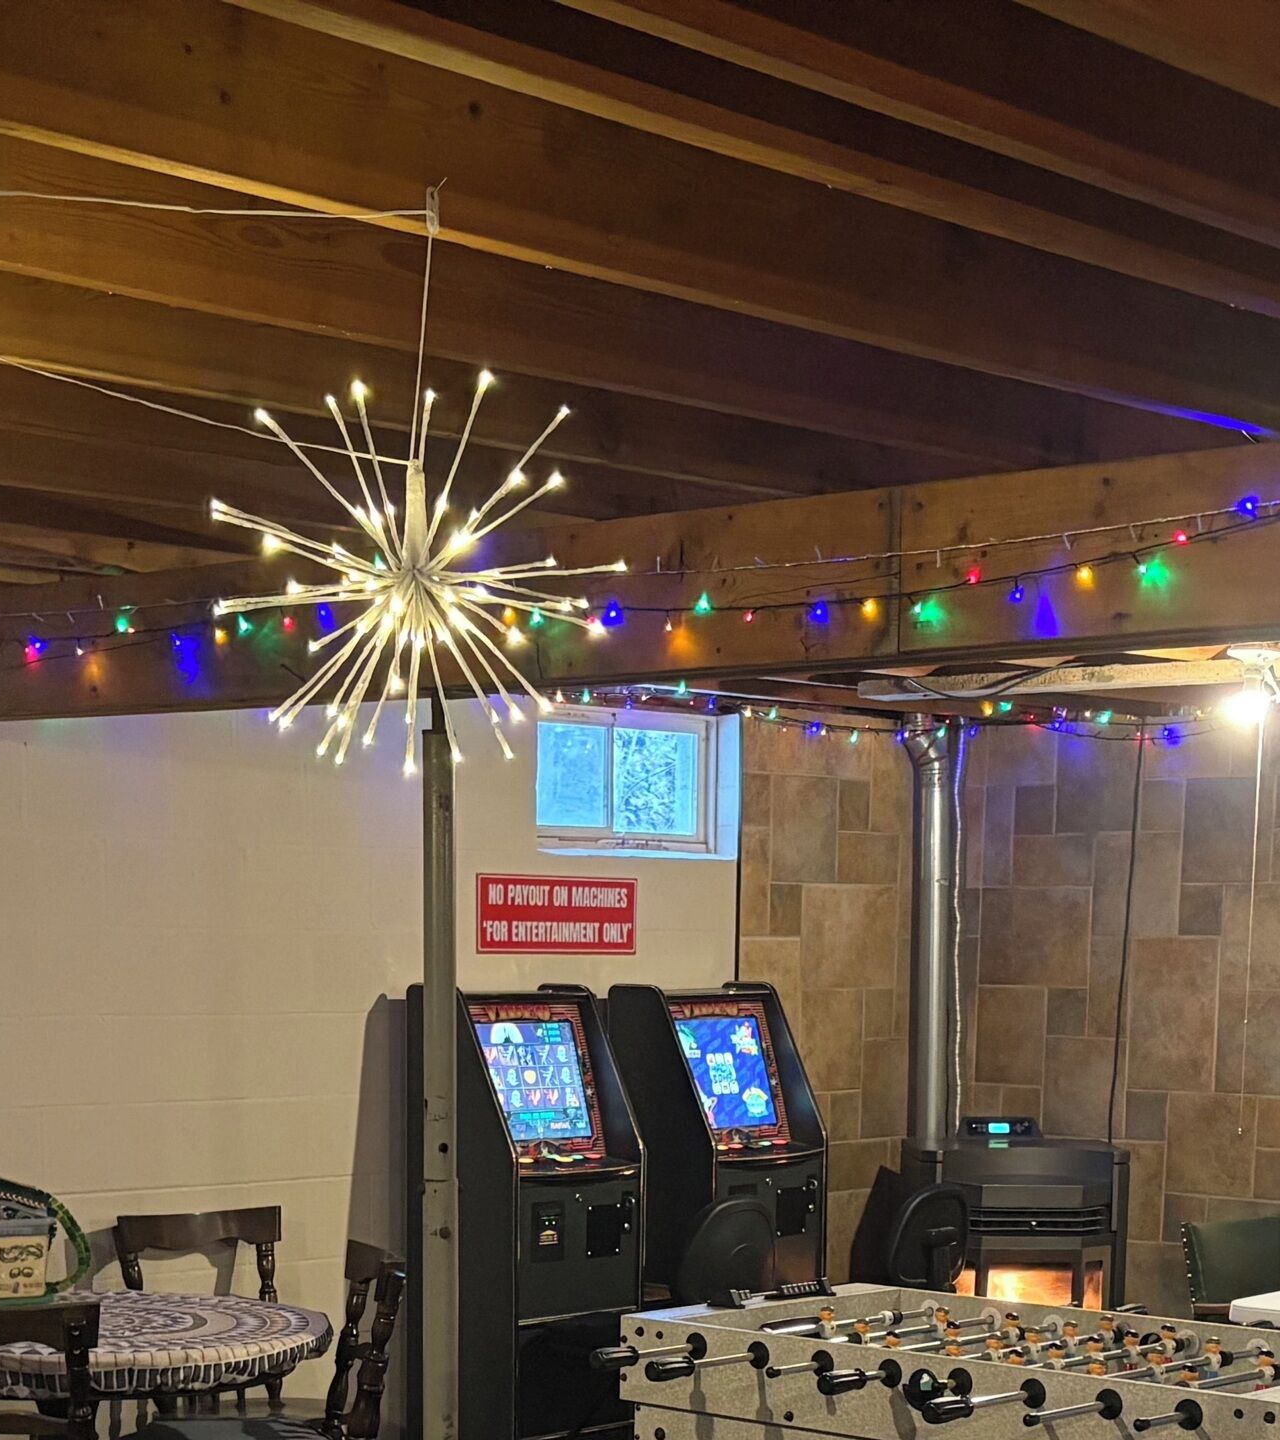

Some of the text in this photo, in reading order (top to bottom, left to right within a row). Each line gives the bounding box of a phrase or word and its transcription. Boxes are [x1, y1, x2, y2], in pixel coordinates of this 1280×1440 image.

[488, 883, 628, 908] NO PAYOUT ON MACHINES
[511, 920, 600, 943] ENTERTAINMENT
